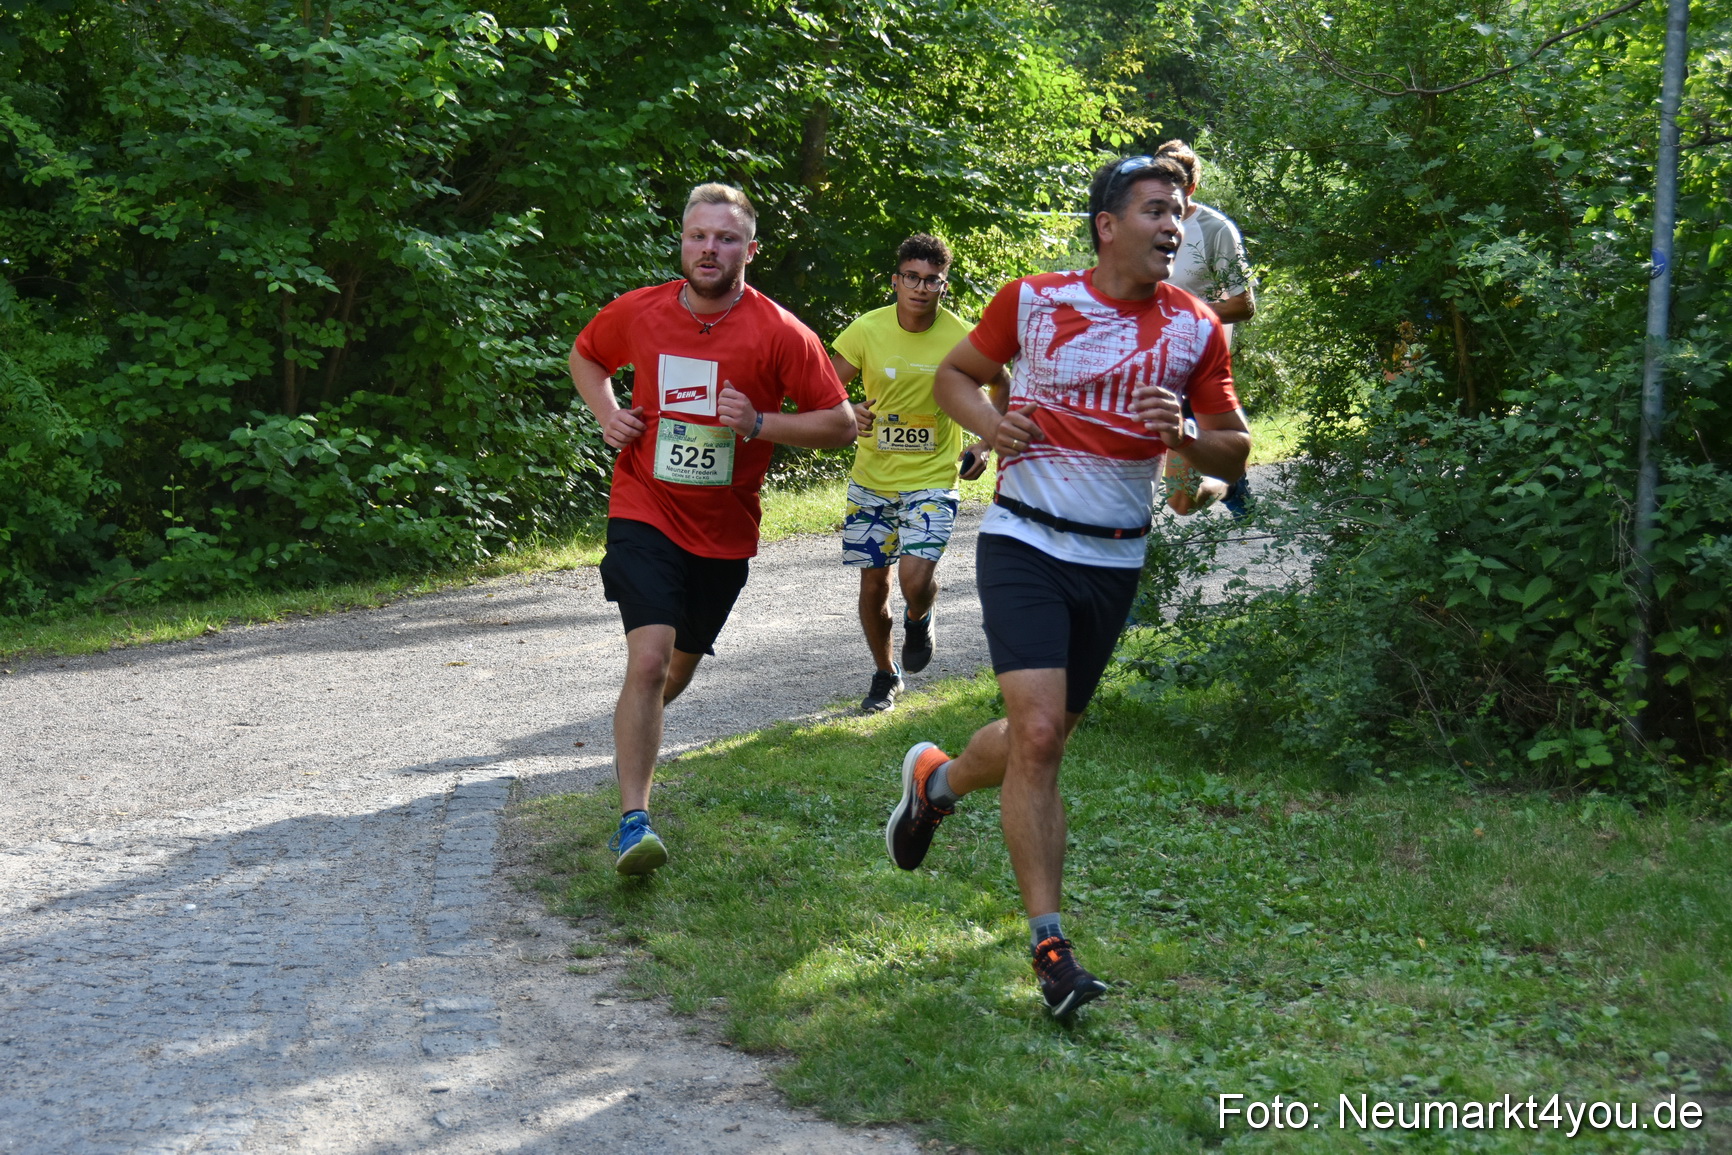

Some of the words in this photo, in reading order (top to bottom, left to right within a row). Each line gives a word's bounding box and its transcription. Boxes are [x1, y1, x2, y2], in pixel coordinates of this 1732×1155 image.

[677, 390, 697, 399] DEHN
[882, 427, 929, 443] 1269
[670, 444, 715, 469] 525
[666, 465, 690, 474] Neunzer
[692, 468, 718, 476] Frederik
